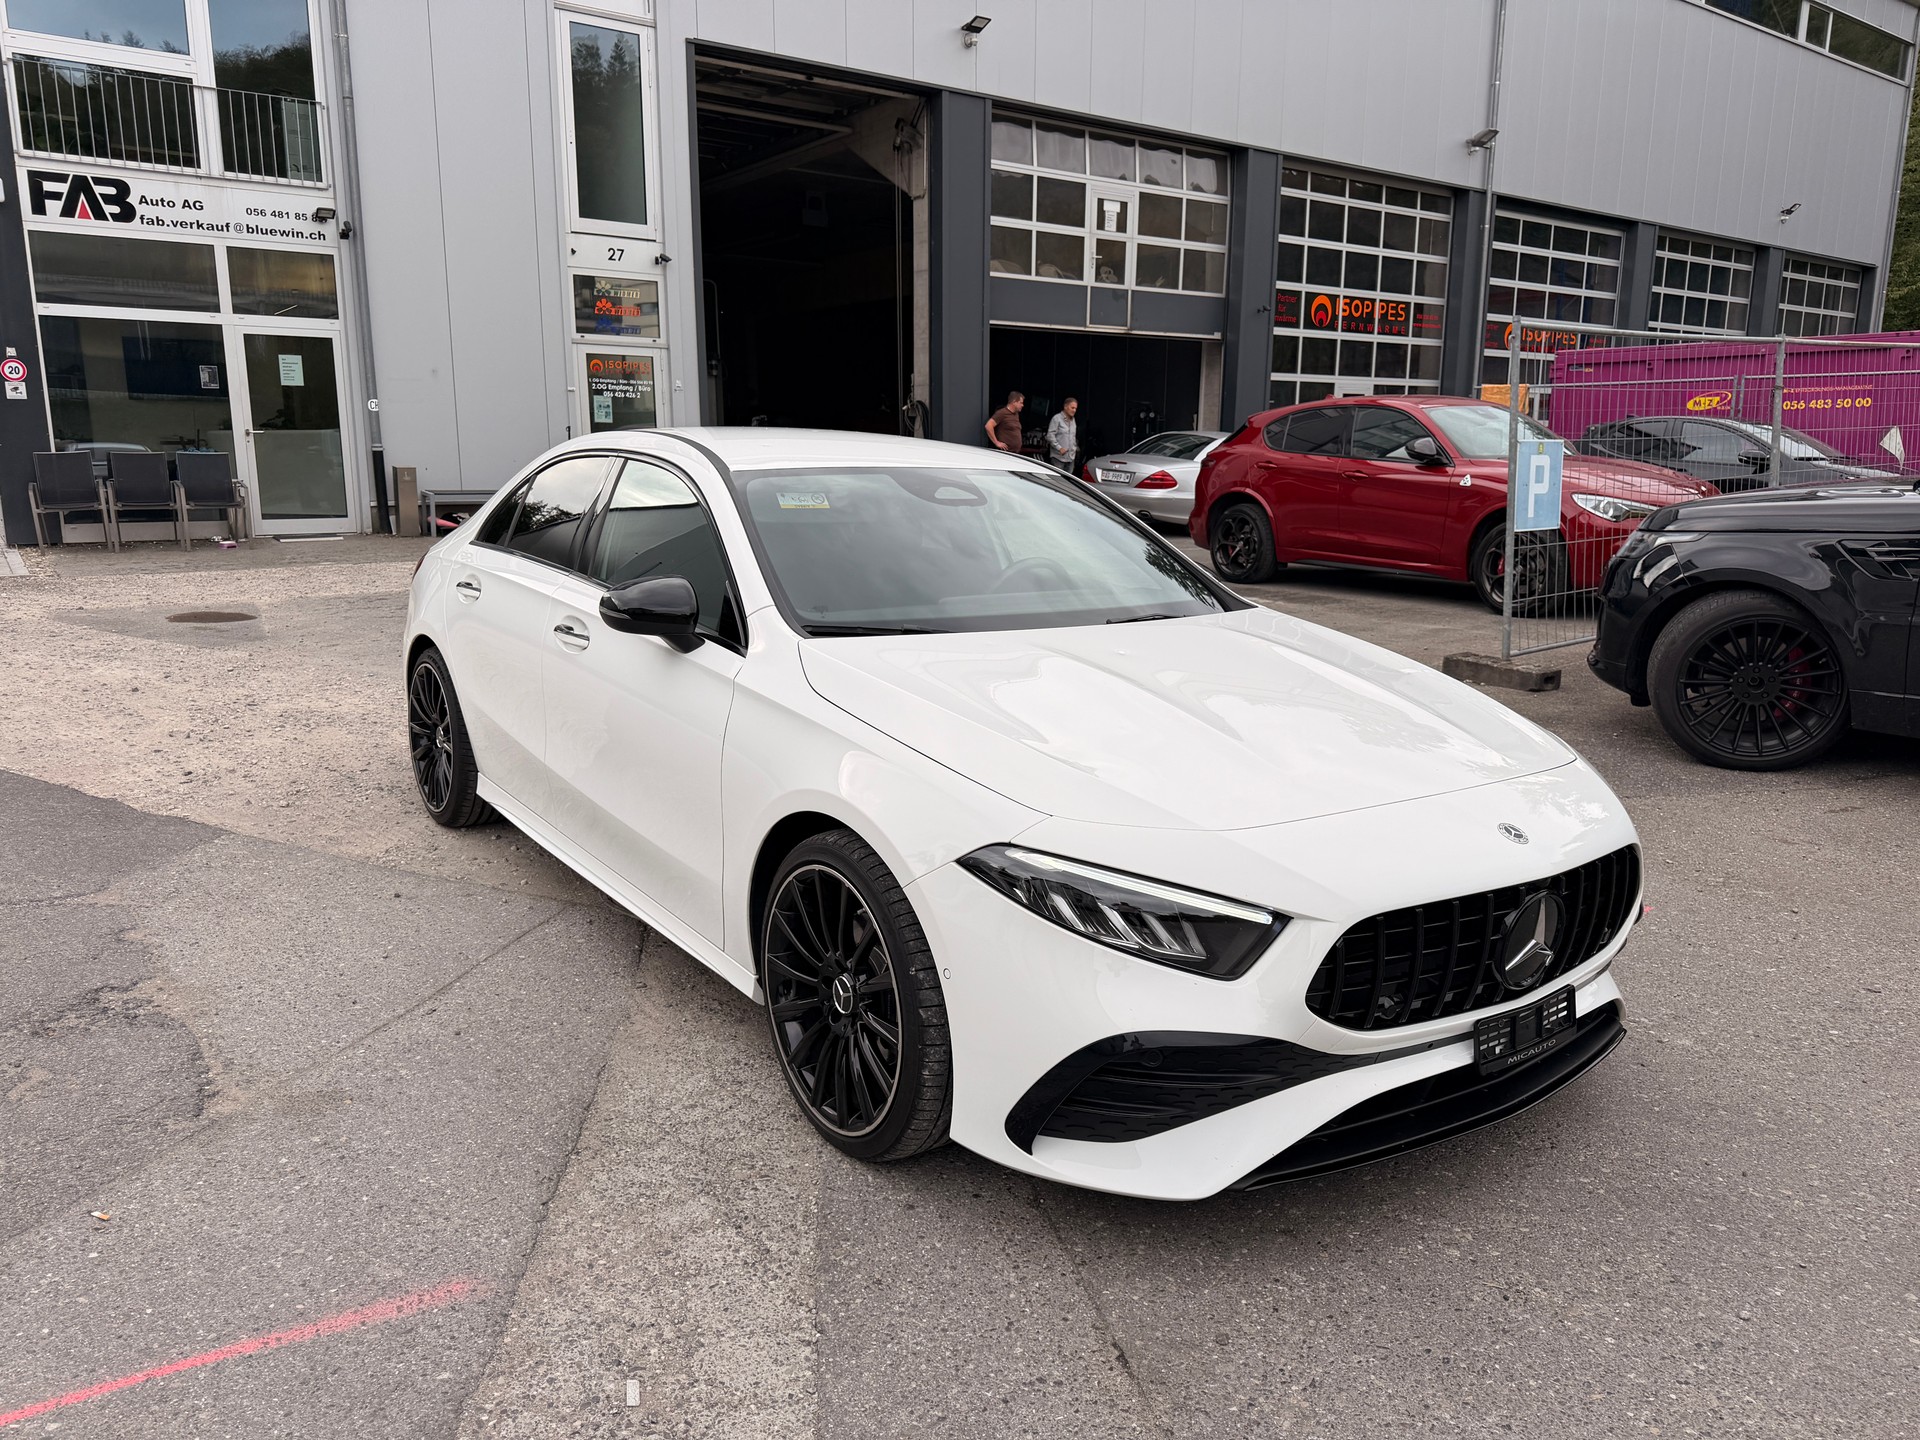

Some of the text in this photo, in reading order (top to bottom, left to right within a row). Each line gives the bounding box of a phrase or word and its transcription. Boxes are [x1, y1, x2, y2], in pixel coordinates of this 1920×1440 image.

[26, 169, 137, 223] FAB
[138, 195, 204, 211] Auto AG
[245, 207, 267, 217] 056
[270, 210, 290, 219] 481
[294, 212, 308, 221] 85
[607, 247, 625, 262] 27
[1277, 293, 1298, 303] Partner
[1335, 298, 1406, 321] ISOPIPES
[1274, 314, 1297, 323] nwärme
[8, 365, 20, 375] 20
[605, 360, 651, 371] ISOPIPES
[608, 384, 633, 392] Empfang
[1783, 397, 1872, 410] 056 483 50 00
[1527, 454, 1551, 518] P
[1507, 1039, 1556, 1065] MICAUTO
